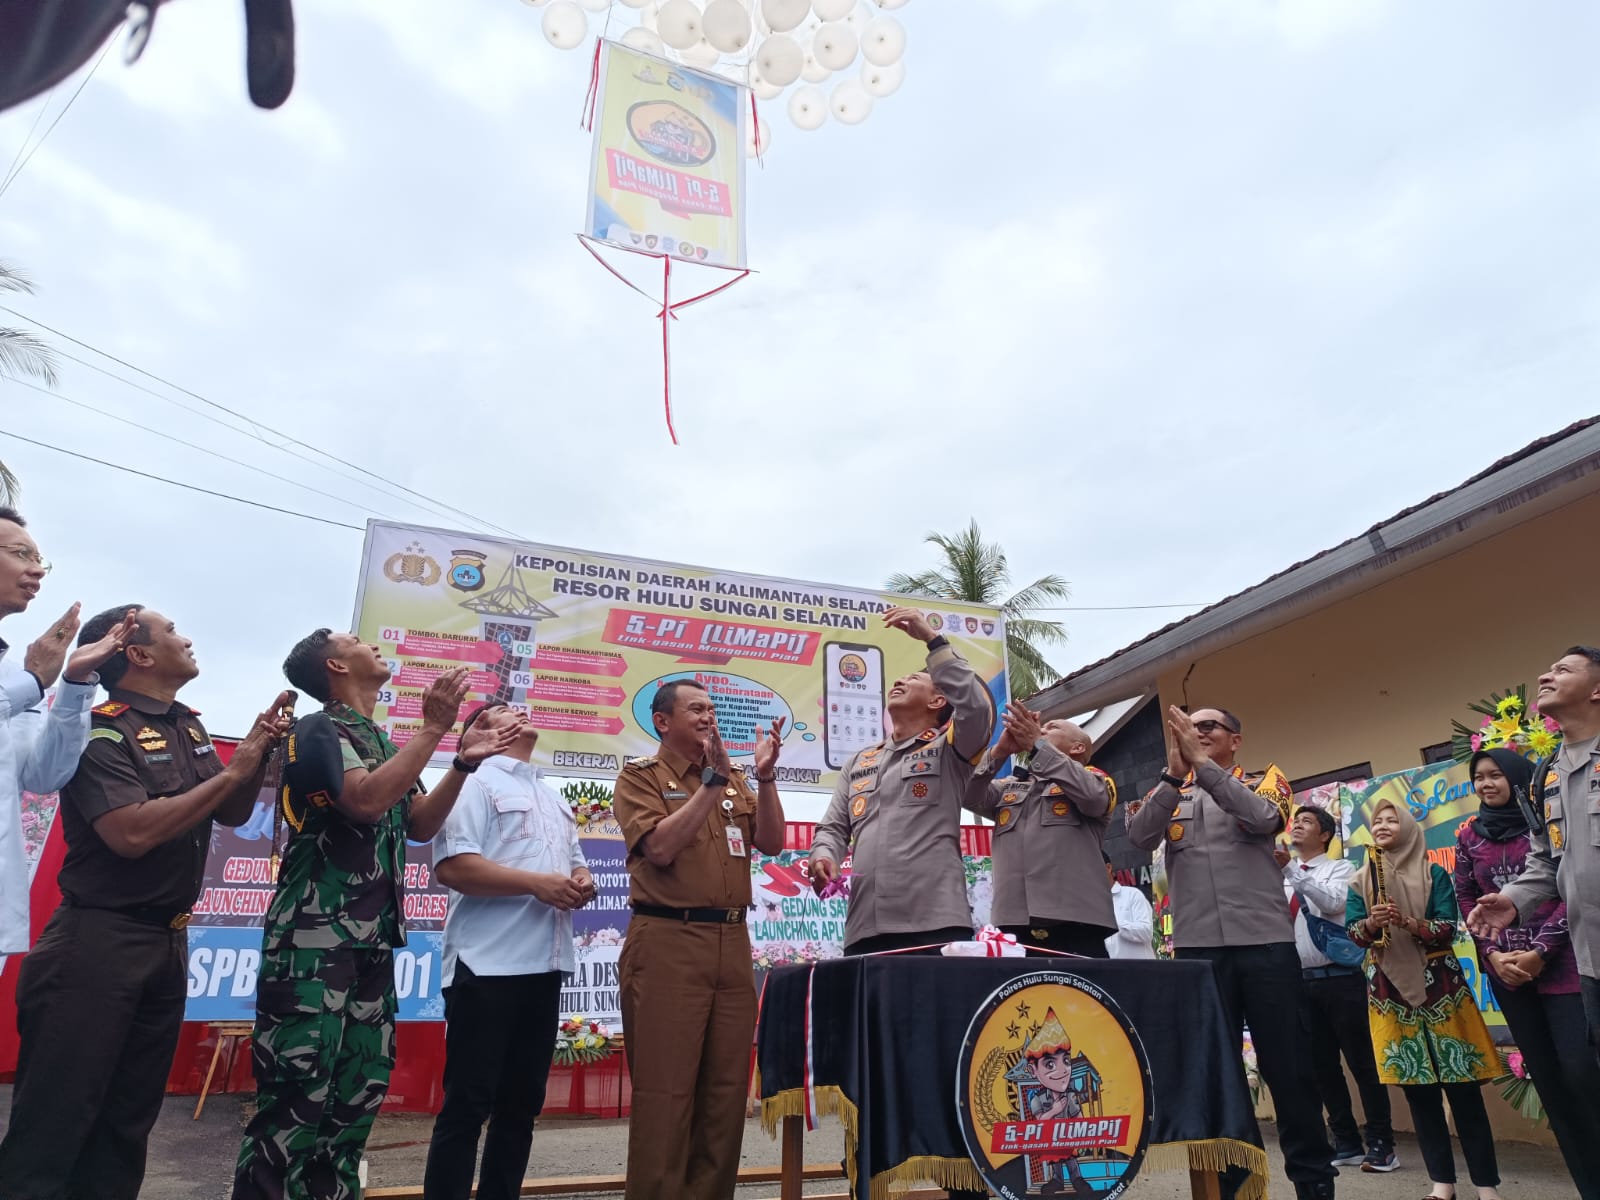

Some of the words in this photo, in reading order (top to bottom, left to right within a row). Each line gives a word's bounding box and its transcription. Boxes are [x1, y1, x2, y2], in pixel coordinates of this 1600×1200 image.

[515, 554, 631, 582] KEPOLISIAN
[636, 571, 710, 593] DAERAH
[715, 582, 824, 607] KALIMANTAN
[552, 577, 631, 601] RESOR
[636, 588, 694, 609] HULU
[699, 597, 777, 620] SUNGAI
[782, 608, 866, 631] SELATAN
[383, 629, 400, 641] 01
[408, 629, 441, 639] TOMBOL
[442, 633, 478, 643] DARURAT
[625, 614, 688, 639] 5-Pi
[516, 644, 532, 655] 05
[388, 661, 396, 672] 2
[513, 673, 530, 685] 06
[570, 708, 598, 716] SERVICE
[553, 751, 619, 770] BEKERJA
[903, 748, 938, 763] POLRI
[781, 897, 828, 918] GEDUNG
[754, 920, 819, 941] LAUNCHING
[998, 981, 1023, 999] Polres
[1022, 974, 1042, 986] Hulu
[1043, 974, 1072, 985] Sungai
[1072, 978, 1102, 1000] Selatan
[560, 991, 591, 1013] HULU
[1004, 1122, 1044, 1142] 5-Pi
